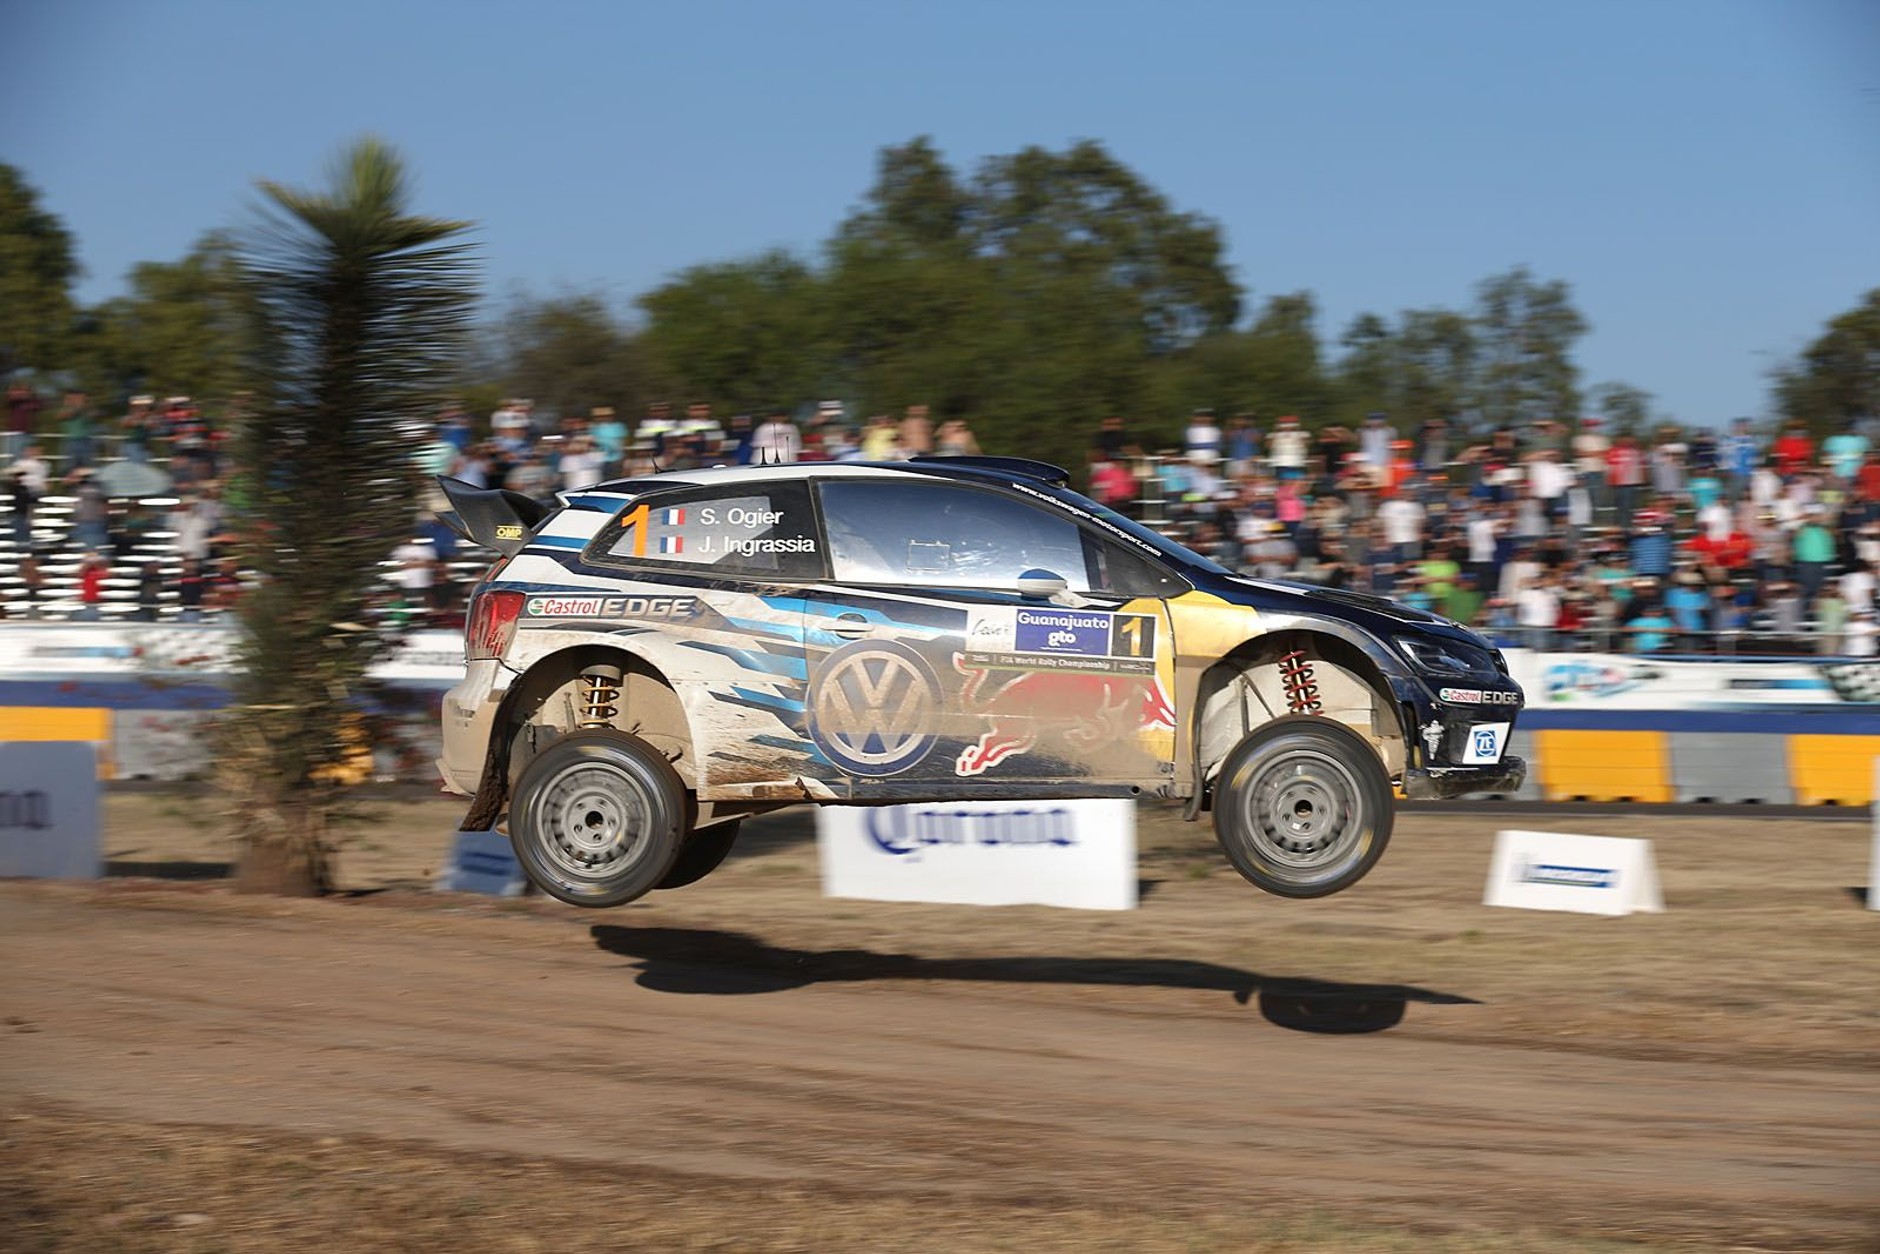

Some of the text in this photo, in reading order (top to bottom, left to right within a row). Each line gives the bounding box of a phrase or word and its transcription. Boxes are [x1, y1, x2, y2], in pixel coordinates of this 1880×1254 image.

[700, 507, 785, 528] S. Ogier
[1012, 482, 1162, 557] www.volkswagen-motorsport.com
[496, 527, 522, 538] OMP
[621, 504, 650, 557] 1
[698, 534, 816, 557] J. Ingrassia
[544, 598, 696, 617] Castrol EDGE
[1017, 611, 1109, 631] Guanajuato
[1047, 630, 1077, 647] gto
[1121, 616, 1143, 657] 1
[1014, 656, 1037, 666] World
[1038, 657, 1058, 669] Rally
[1058, 658, 1111, 672] Championship
[1482, 690, 1518, 705] EDGE
